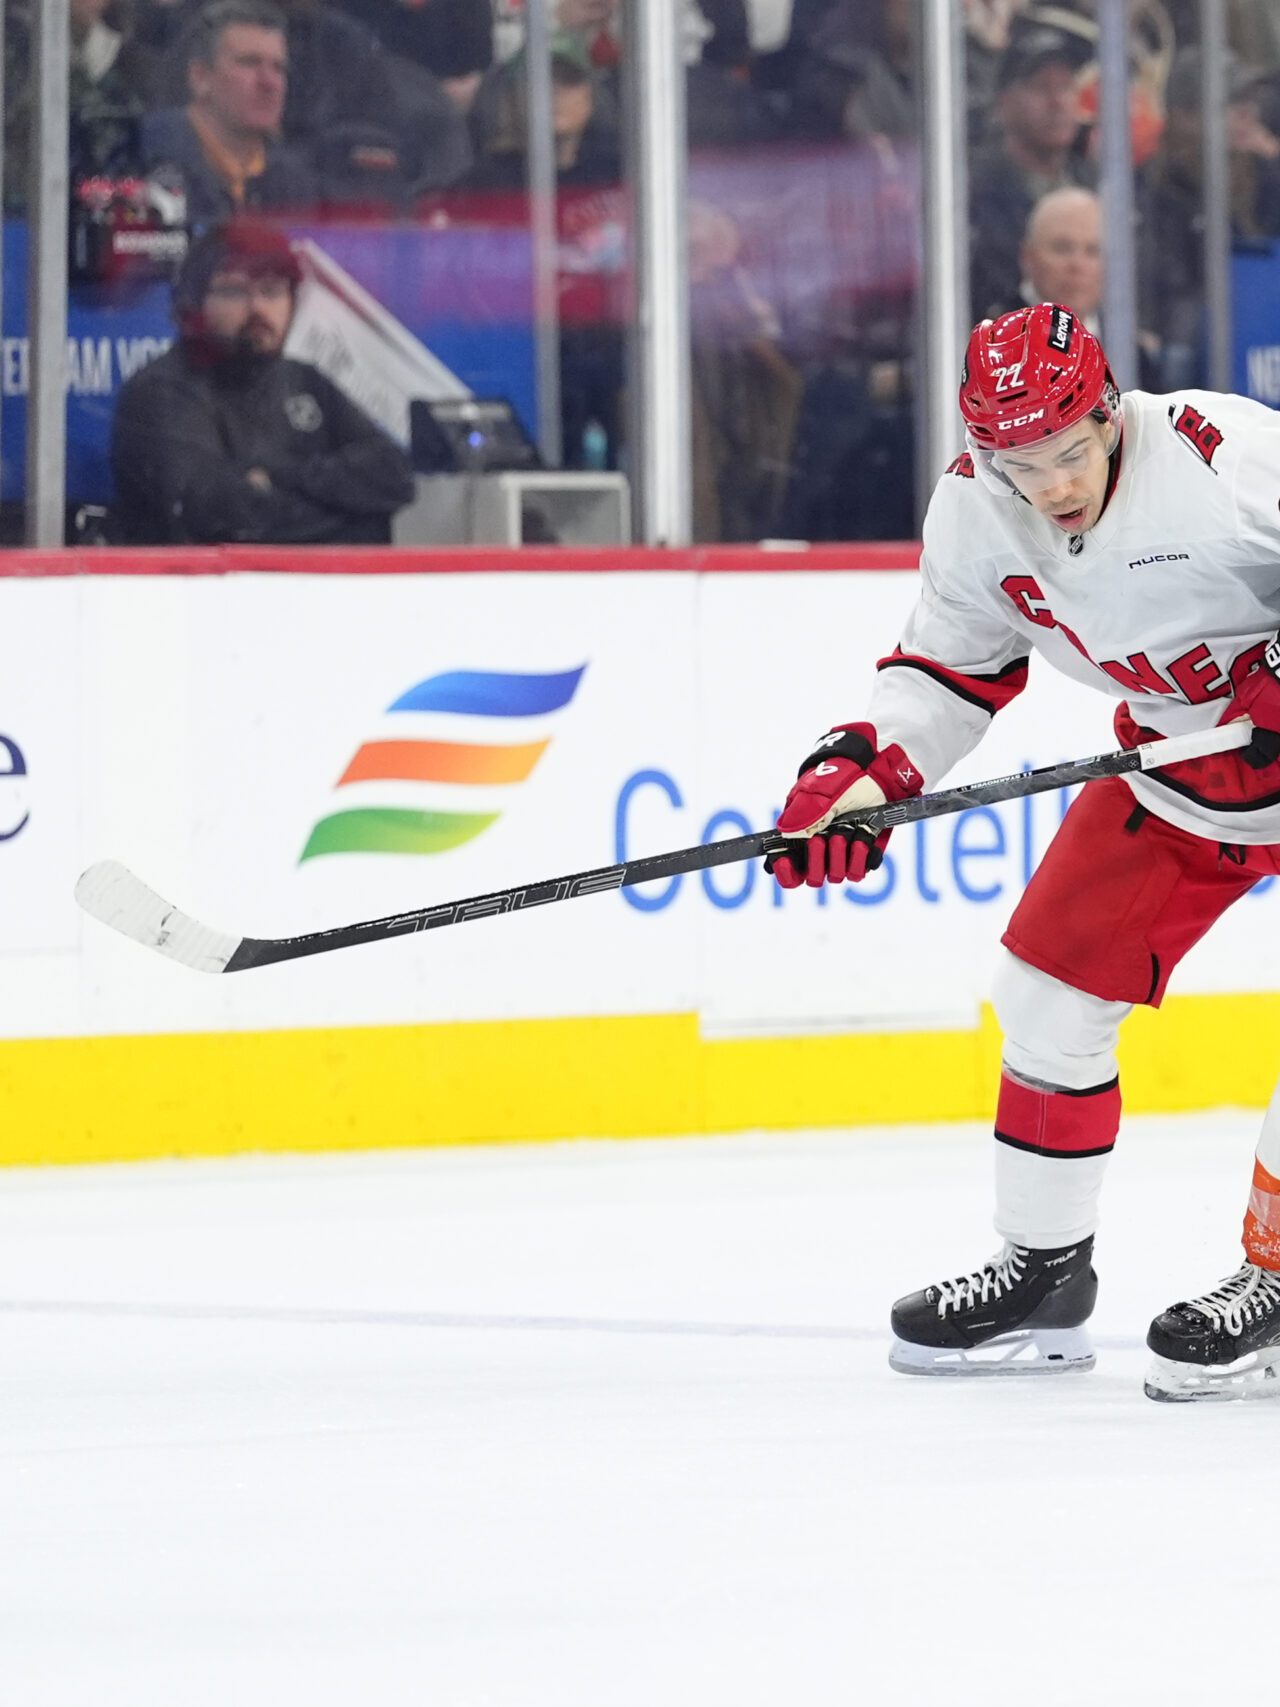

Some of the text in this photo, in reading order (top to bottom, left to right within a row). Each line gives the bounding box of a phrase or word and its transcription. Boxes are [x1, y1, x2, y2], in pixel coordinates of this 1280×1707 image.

[990, 363, 1025, 393] 22
[997, 408, 1045, 431] CCM
[1129, 553, 1190, 569] NUCOR
[387, 868, 627, 932] TRUE
[1044, 1248, 1077, 1268] TRUE
